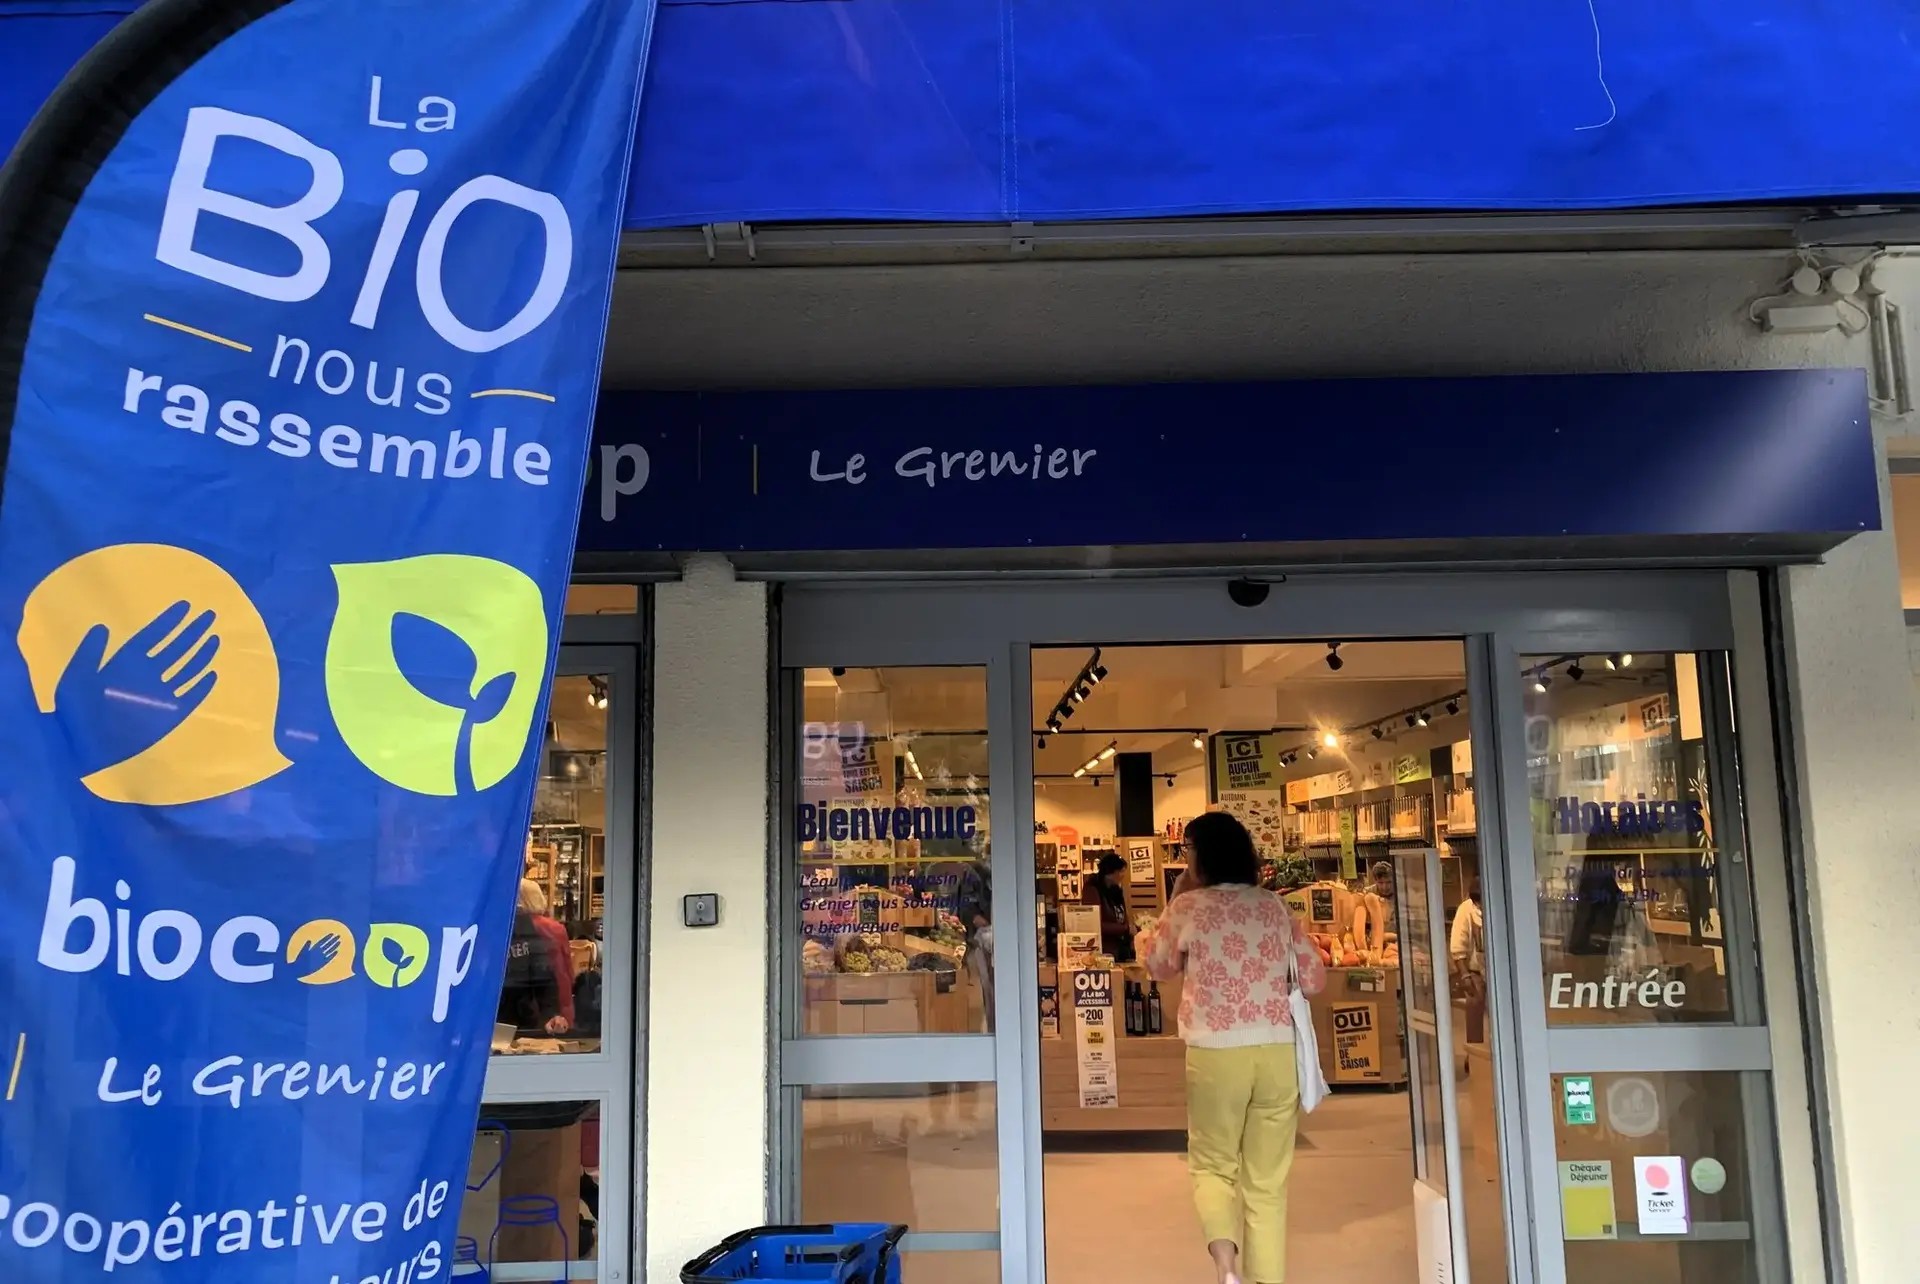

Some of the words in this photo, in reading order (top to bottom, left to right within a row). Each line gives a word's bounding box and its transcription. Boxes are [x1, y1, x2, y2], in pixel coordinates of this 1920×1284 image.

[368, 75, 456, 133] La
[269, 334, 453, 416] nous
[123, 368, 551, 486] rassemble
[810, 450, 866, 484] Le
[895, 444, 1097, 487] Grenier
[1226, 740, 1261, 758] ICI
[1229, 760, 1260, 775] AUCUN
[797, 801, 976, 842] Bienvenue
[1557, 793, 1705, 834] Horaires
[1131, 849, 1149, 859] ICI
[800, 895, 858, 912] Grenier
[800, 920, 815, 935] la
[1075, 973, 1110, 990] OUI
[1549, 968, 1686, 1009] Entrée
[1085, 1009, 1103, 1020] 200
[1335, 1011, 1371, 1029] OUI
[1339, 1049, 1349, 1060] DE
[1340, 1057, 1370, 1070] SAISON
[98, 1056, 162, 1106] Le
[192, 1055, 446, 1109] Grenier
[1569, 1163, 1602, 1174] Chèque
[1570, 1172, 1609, 1183] Déjeuner
[1648, 1199, 1674, 1208] Ticket
[0, 1194, 387, 1272] oopérative
[403, 1178, 449, 1231] de
